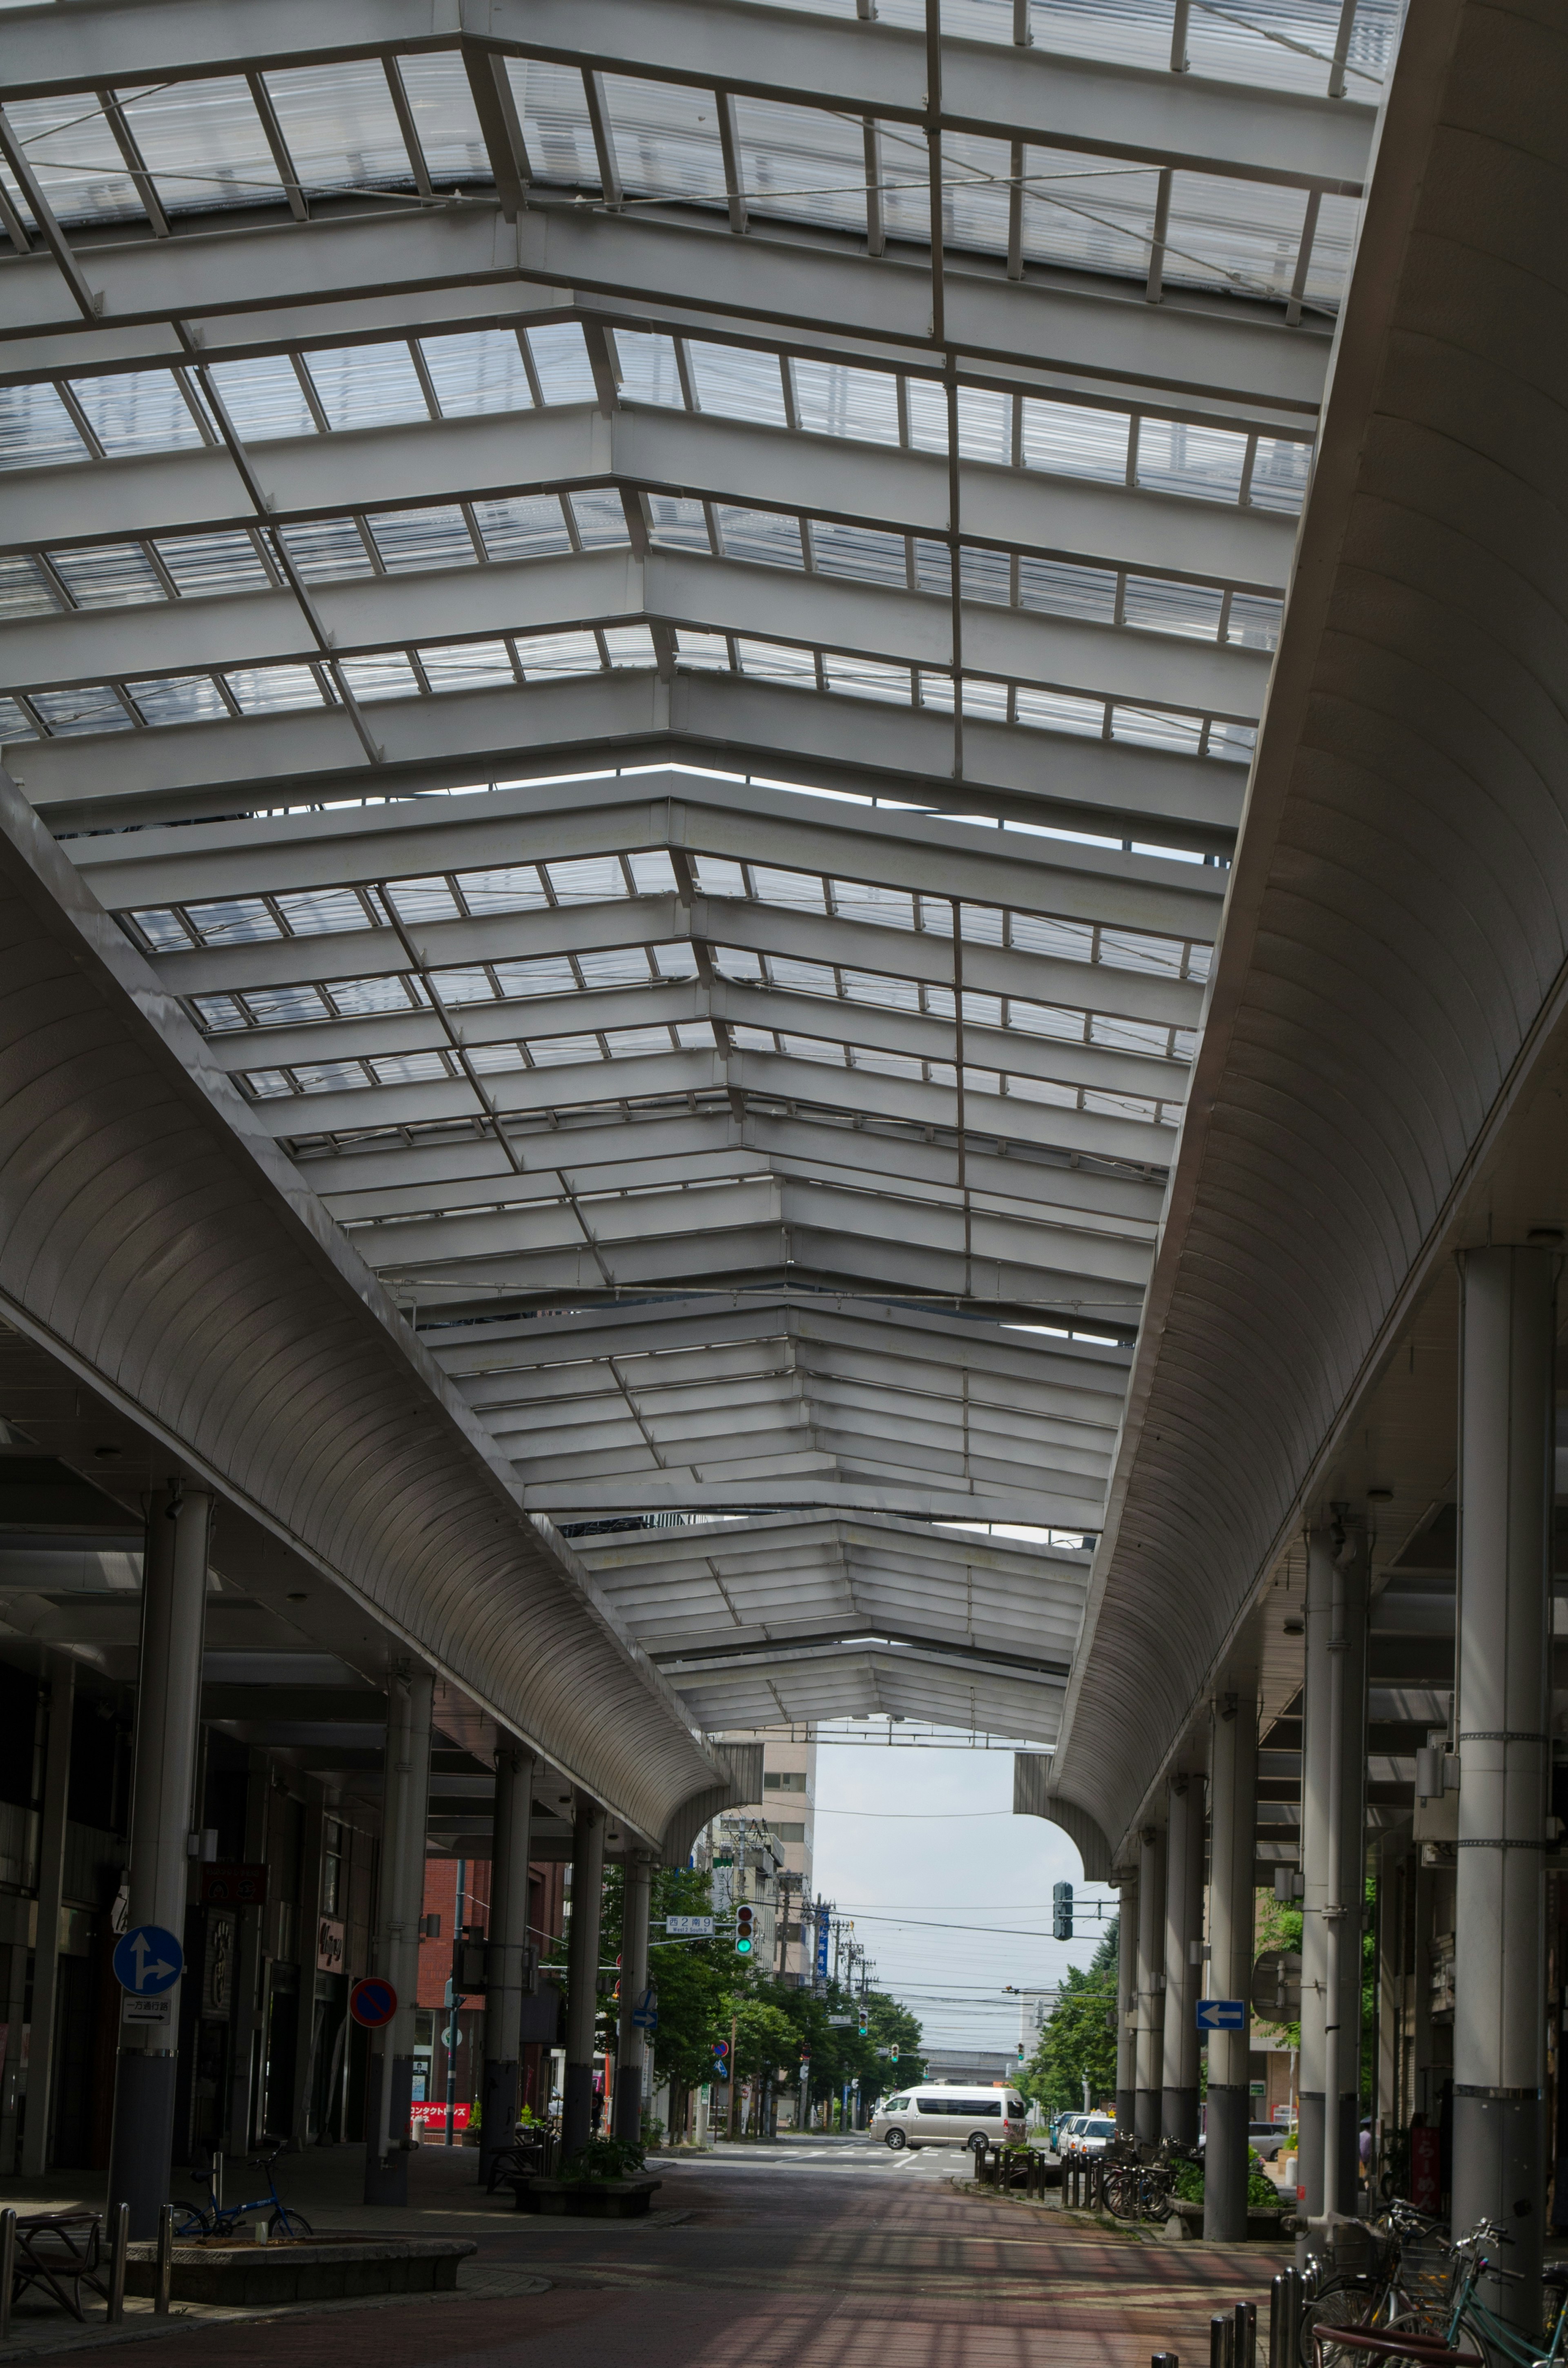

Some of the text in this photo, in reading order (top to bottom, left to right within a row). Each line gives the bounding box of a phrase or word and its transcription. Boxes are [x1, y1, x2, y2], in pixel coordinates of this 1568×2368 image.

[127, 2001, 168, 2011] 一方通行路
[1417, 2140, 1436, 2211] らーめん
